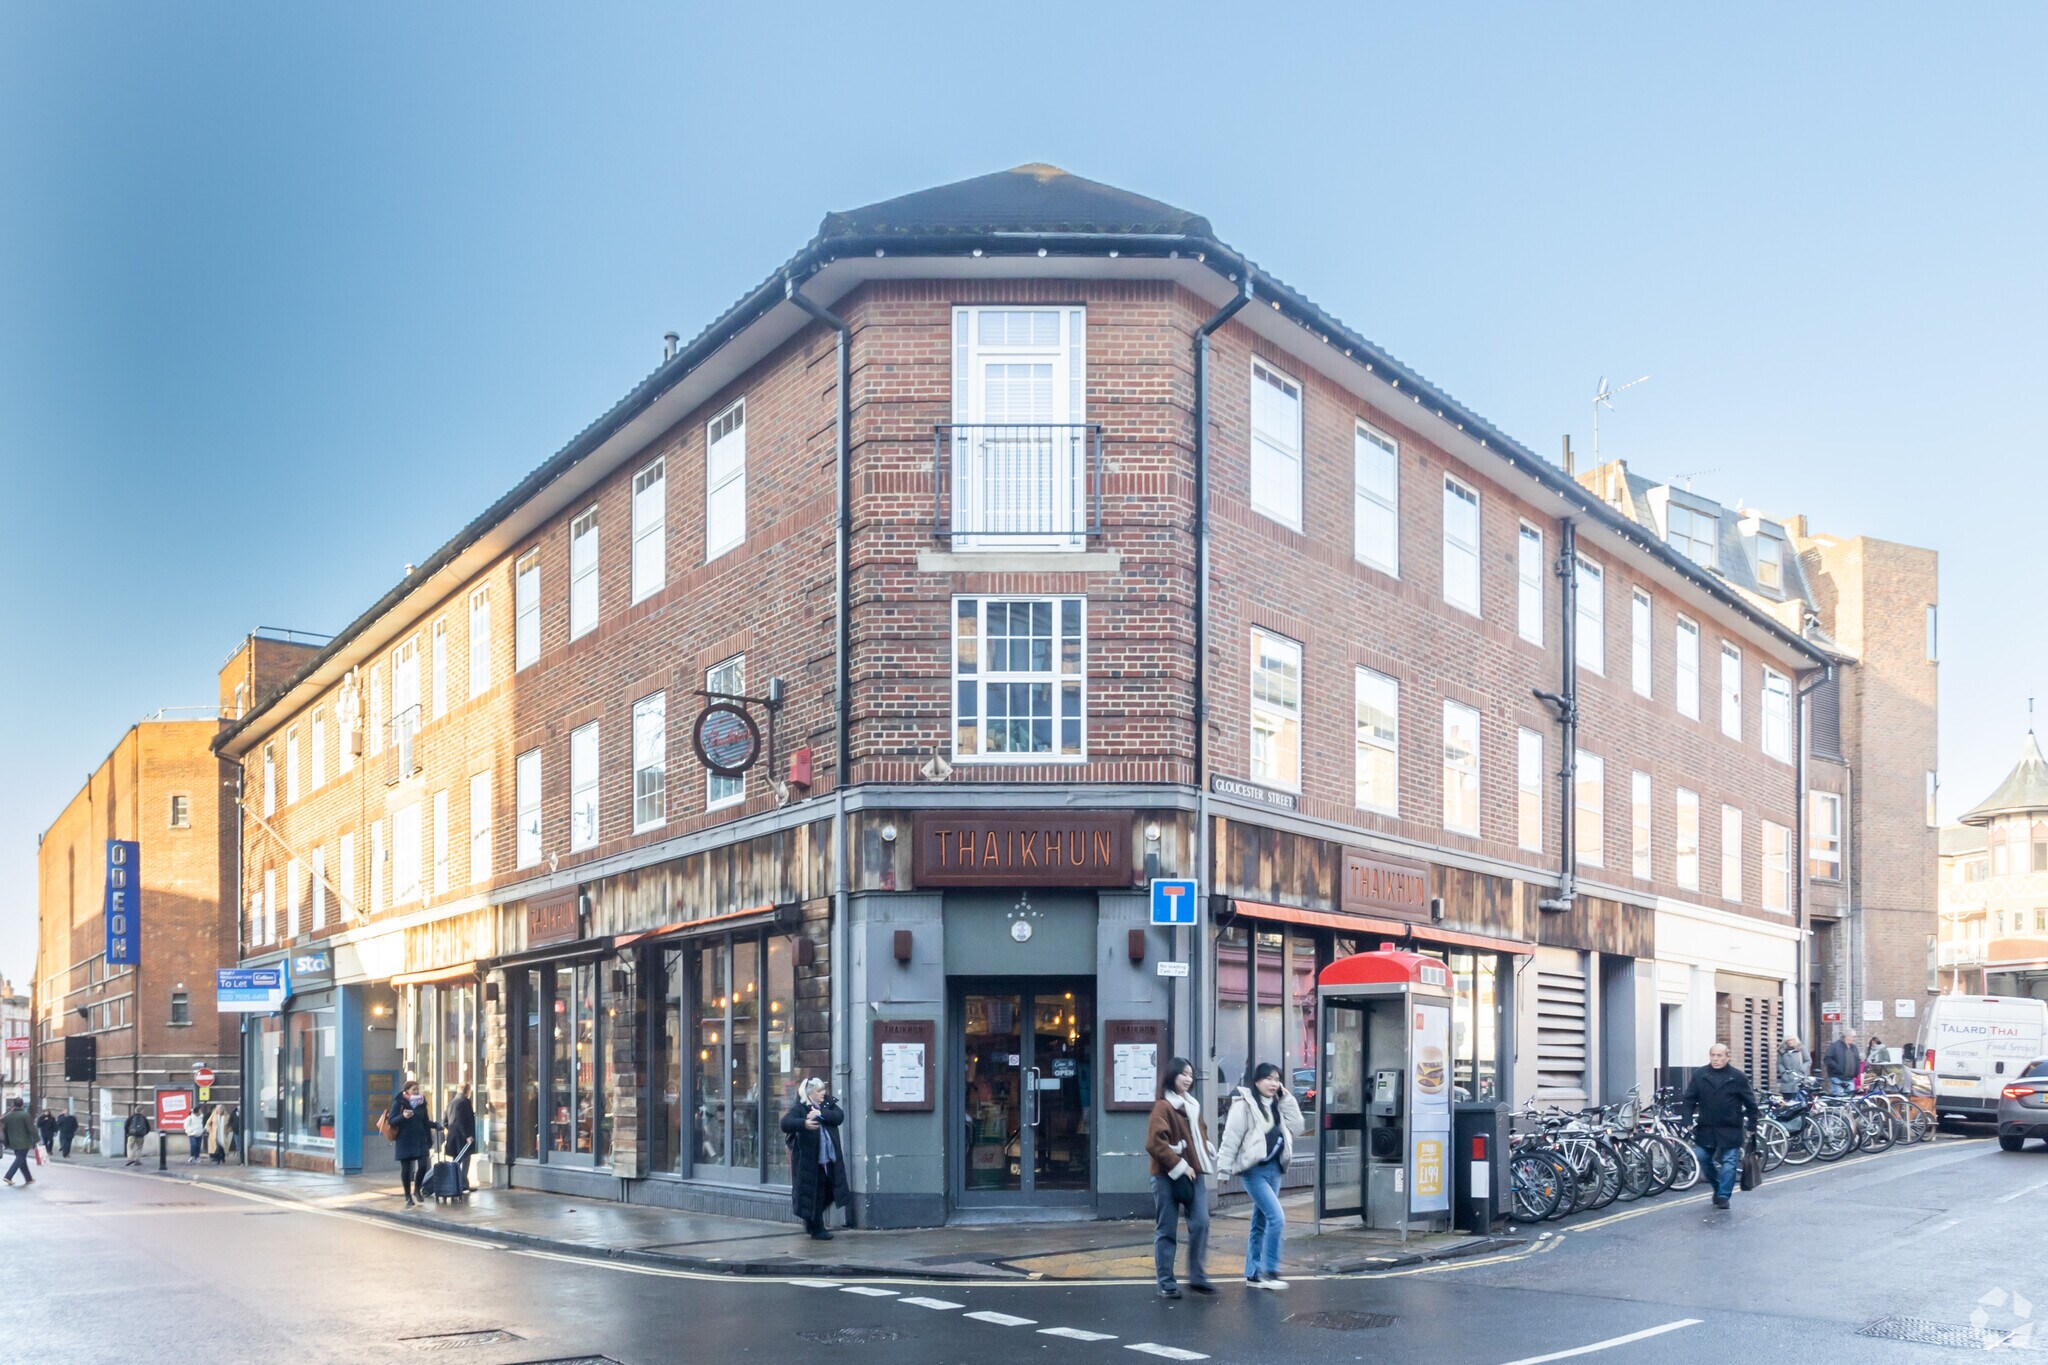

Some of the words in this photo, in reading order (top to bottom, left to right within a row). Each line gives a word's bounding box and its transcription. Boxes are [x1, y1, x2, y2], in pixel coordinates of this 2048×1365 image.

[1215, 779, 1264, 800] GLOUCESTER
[1267, 791, 1293, 807] STREET
[935, 830, 1111, 867] THAIKHUN
[112, 844, 127, 959] ODEON
[1351, 863, 1424, 907] THAIKHUN
[530, 900, 575, 935] THAIKHUN
[1987, 1042, 2008, 1050] Food
[2010, 1043, 2037, 1052] Service
